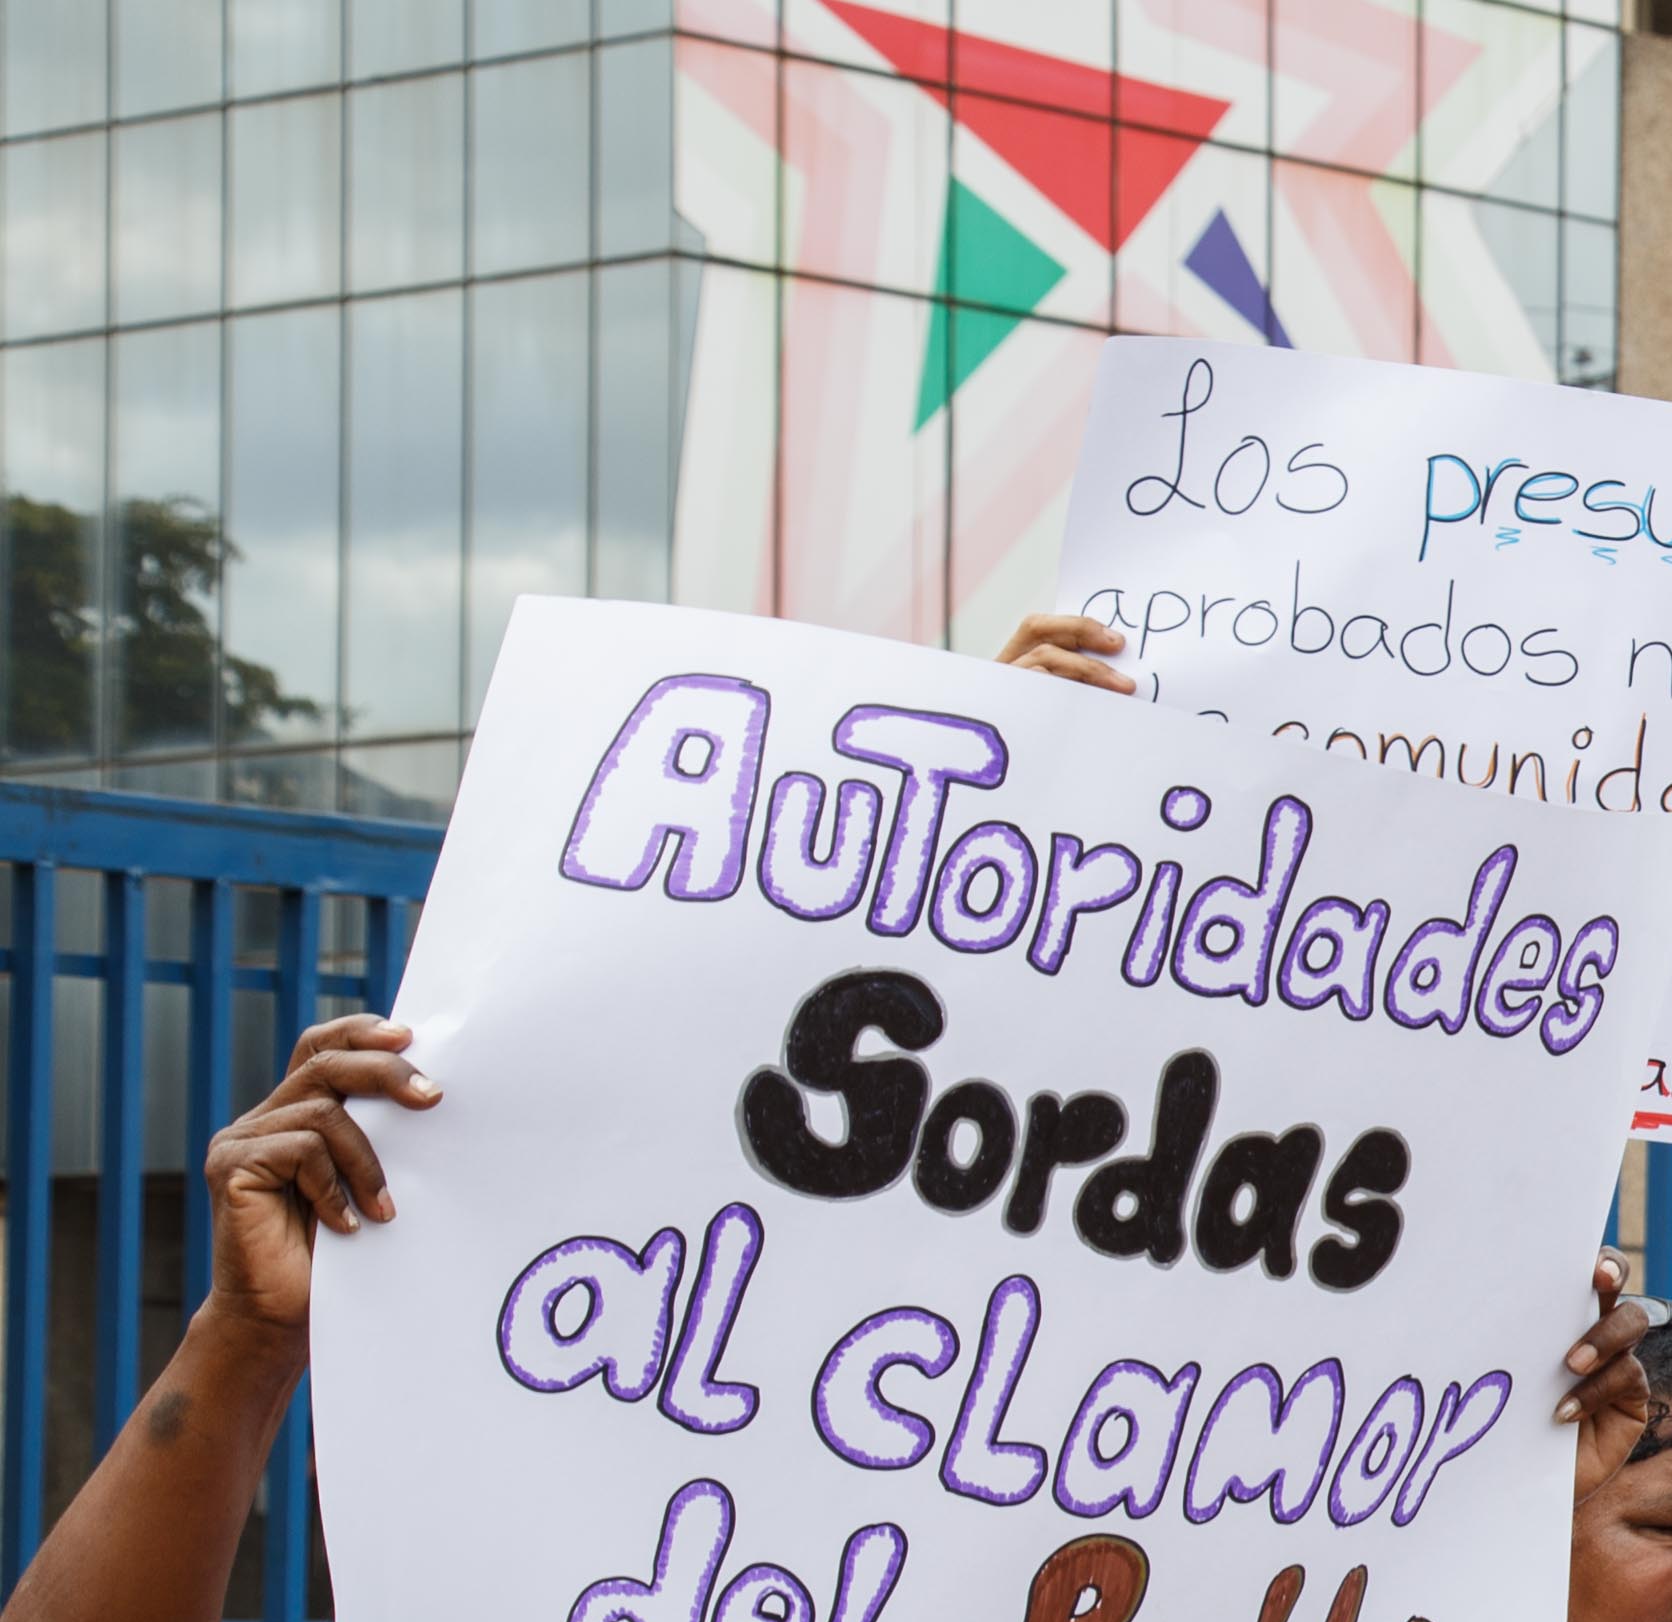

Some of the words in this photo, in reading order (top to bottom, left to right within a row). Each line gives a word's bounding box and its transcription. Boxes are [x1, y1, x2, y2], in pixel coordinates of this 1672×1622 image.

[1126, 358, 1348, 516] Los
[1080, 560, 1580, 689] aprobados
[733, 967, 1414, 1295] Sordas
